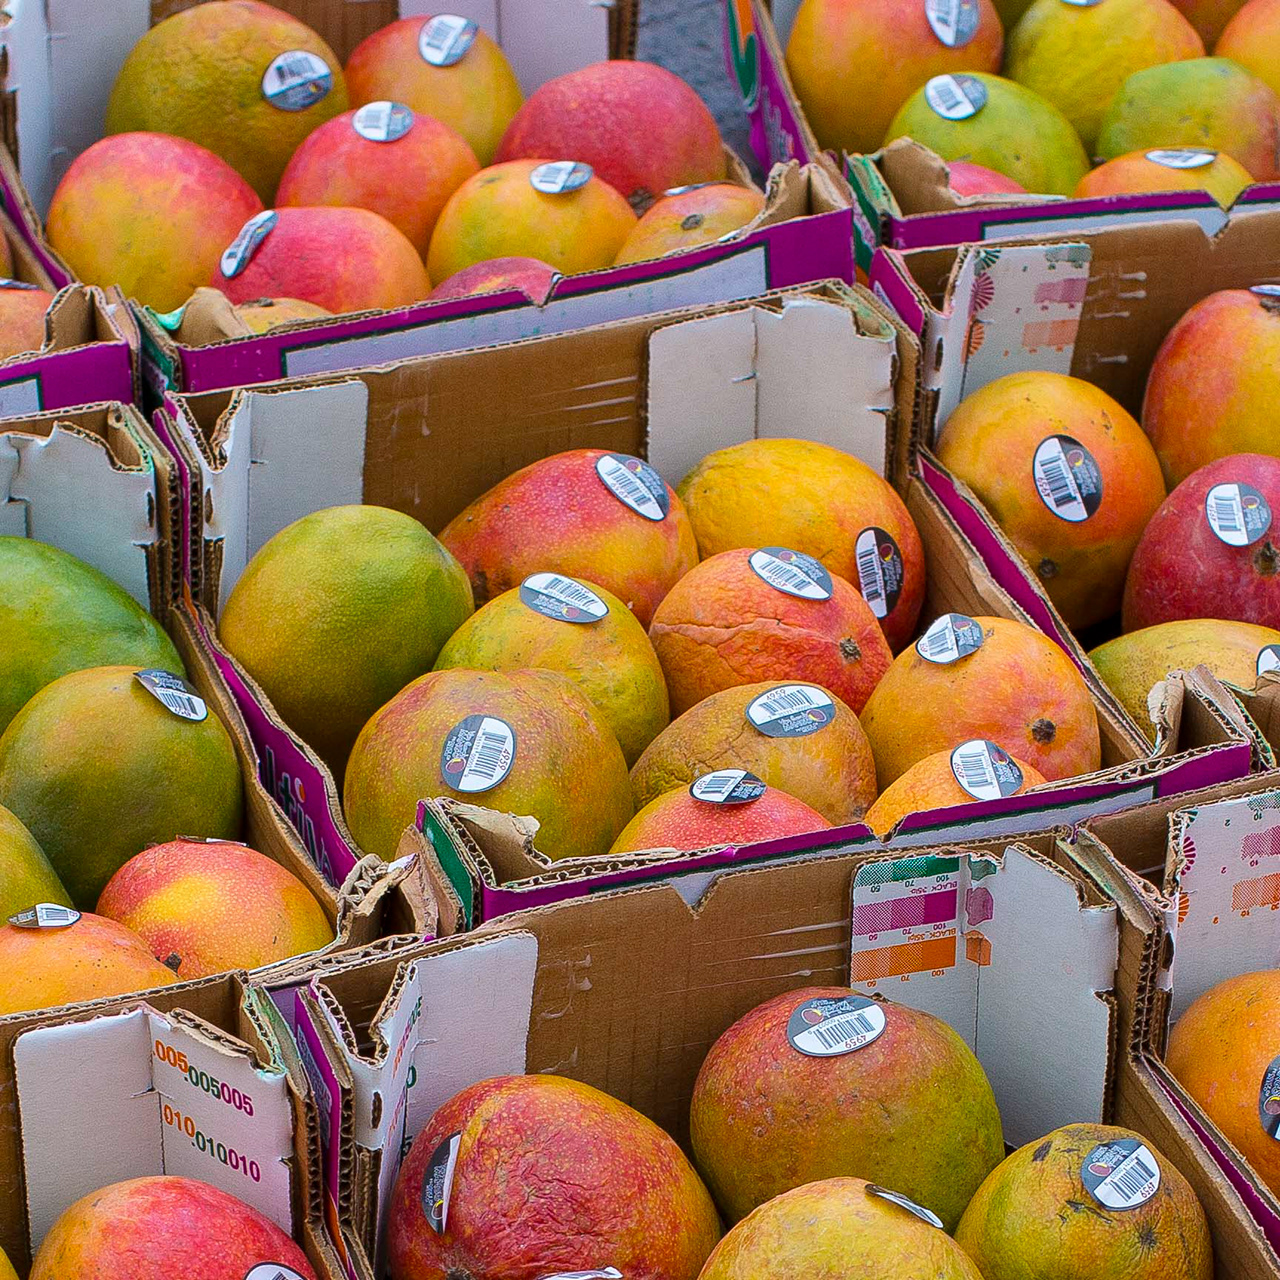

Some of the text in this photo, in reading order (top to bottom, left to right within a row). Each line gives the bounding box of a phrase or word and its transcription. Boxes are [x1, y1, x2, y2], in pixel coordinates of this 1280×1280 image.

[497, 748, 510, 771] 4959
[844, 1035, 867, 1049] 4959
[1140, 1182, 1155, 1198] 4959
